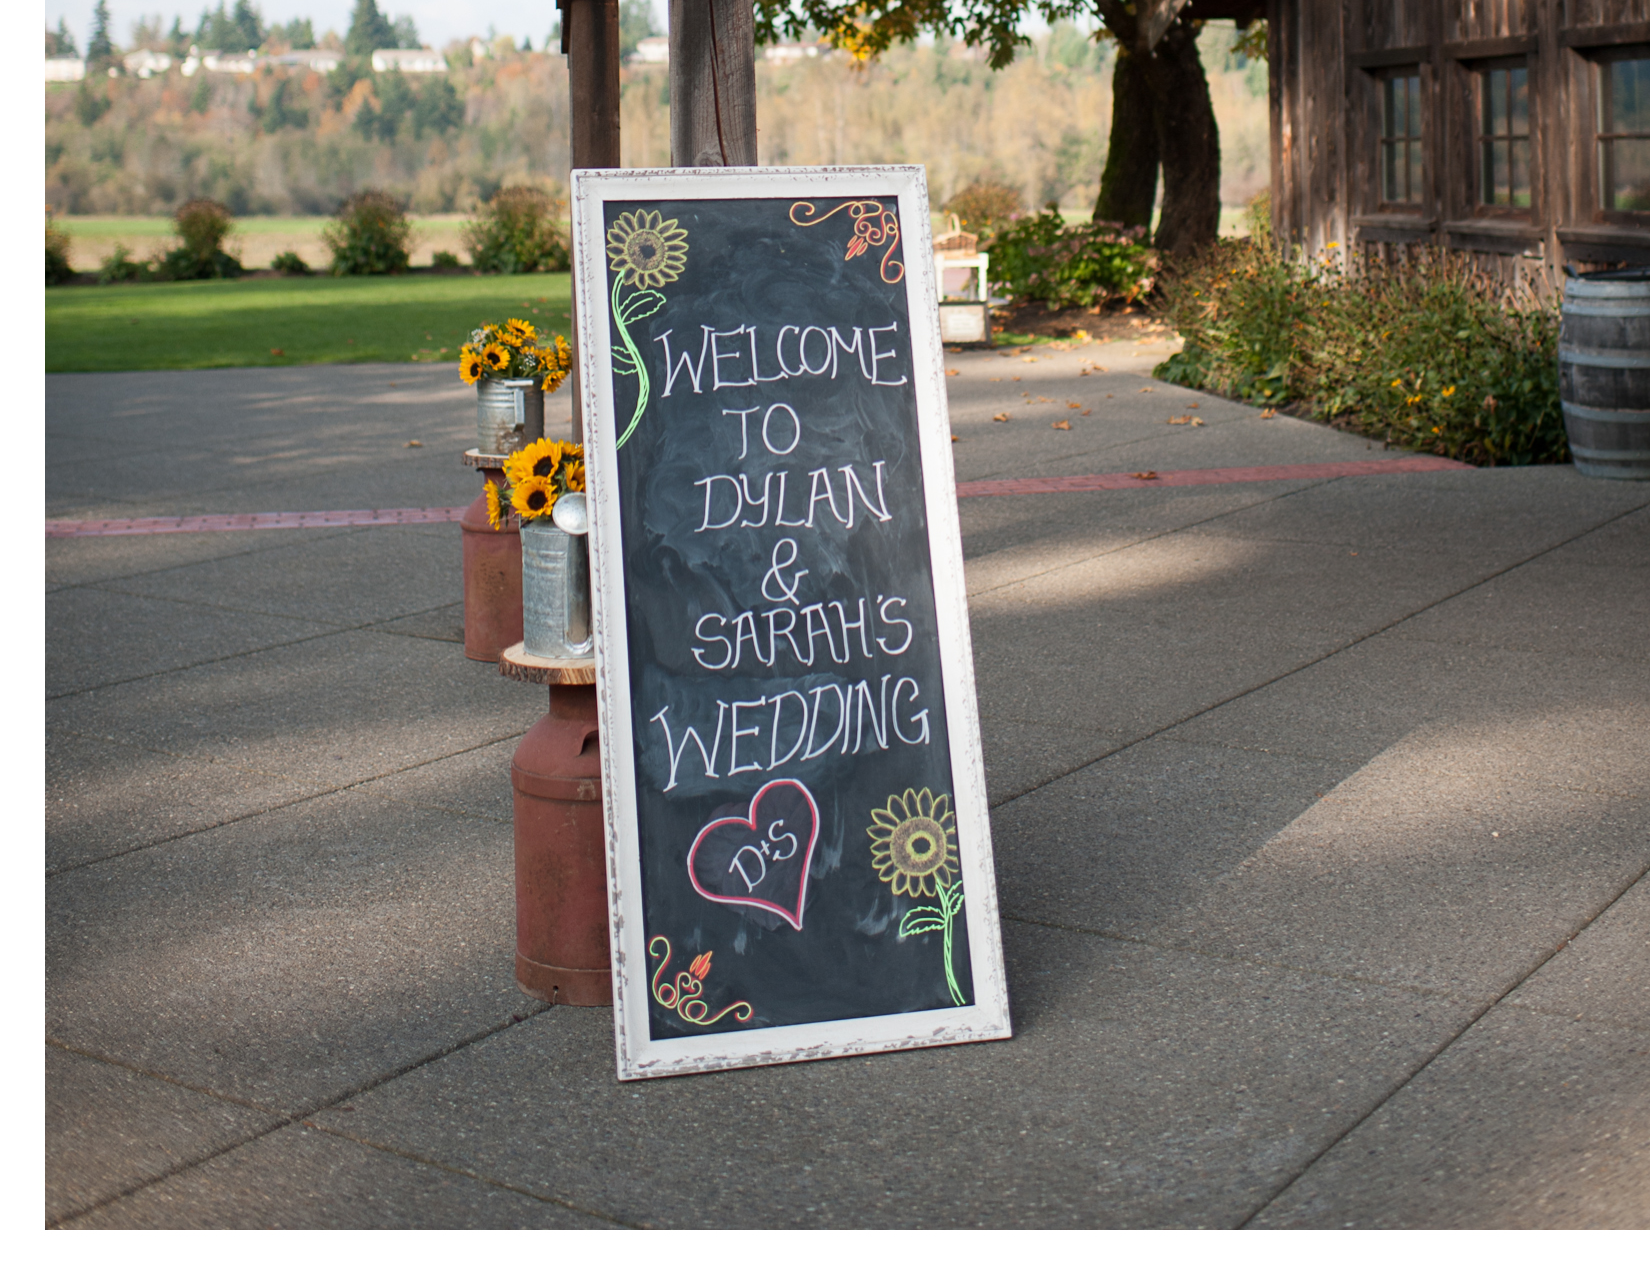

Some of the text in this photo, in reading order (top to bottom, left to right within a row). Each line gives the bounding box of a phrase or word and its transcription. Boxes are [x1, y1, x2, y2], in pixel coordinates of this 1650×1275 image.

[654, 321, 907, 398] WELCOME
[722, 402, 801, 460] TO
[694, 460, 892, 533] DYLAN
[760, 537, 809, 605] &
[691, 596, 912, 669] SARAH'S
[650, 674, 930, 792] WEDDING
